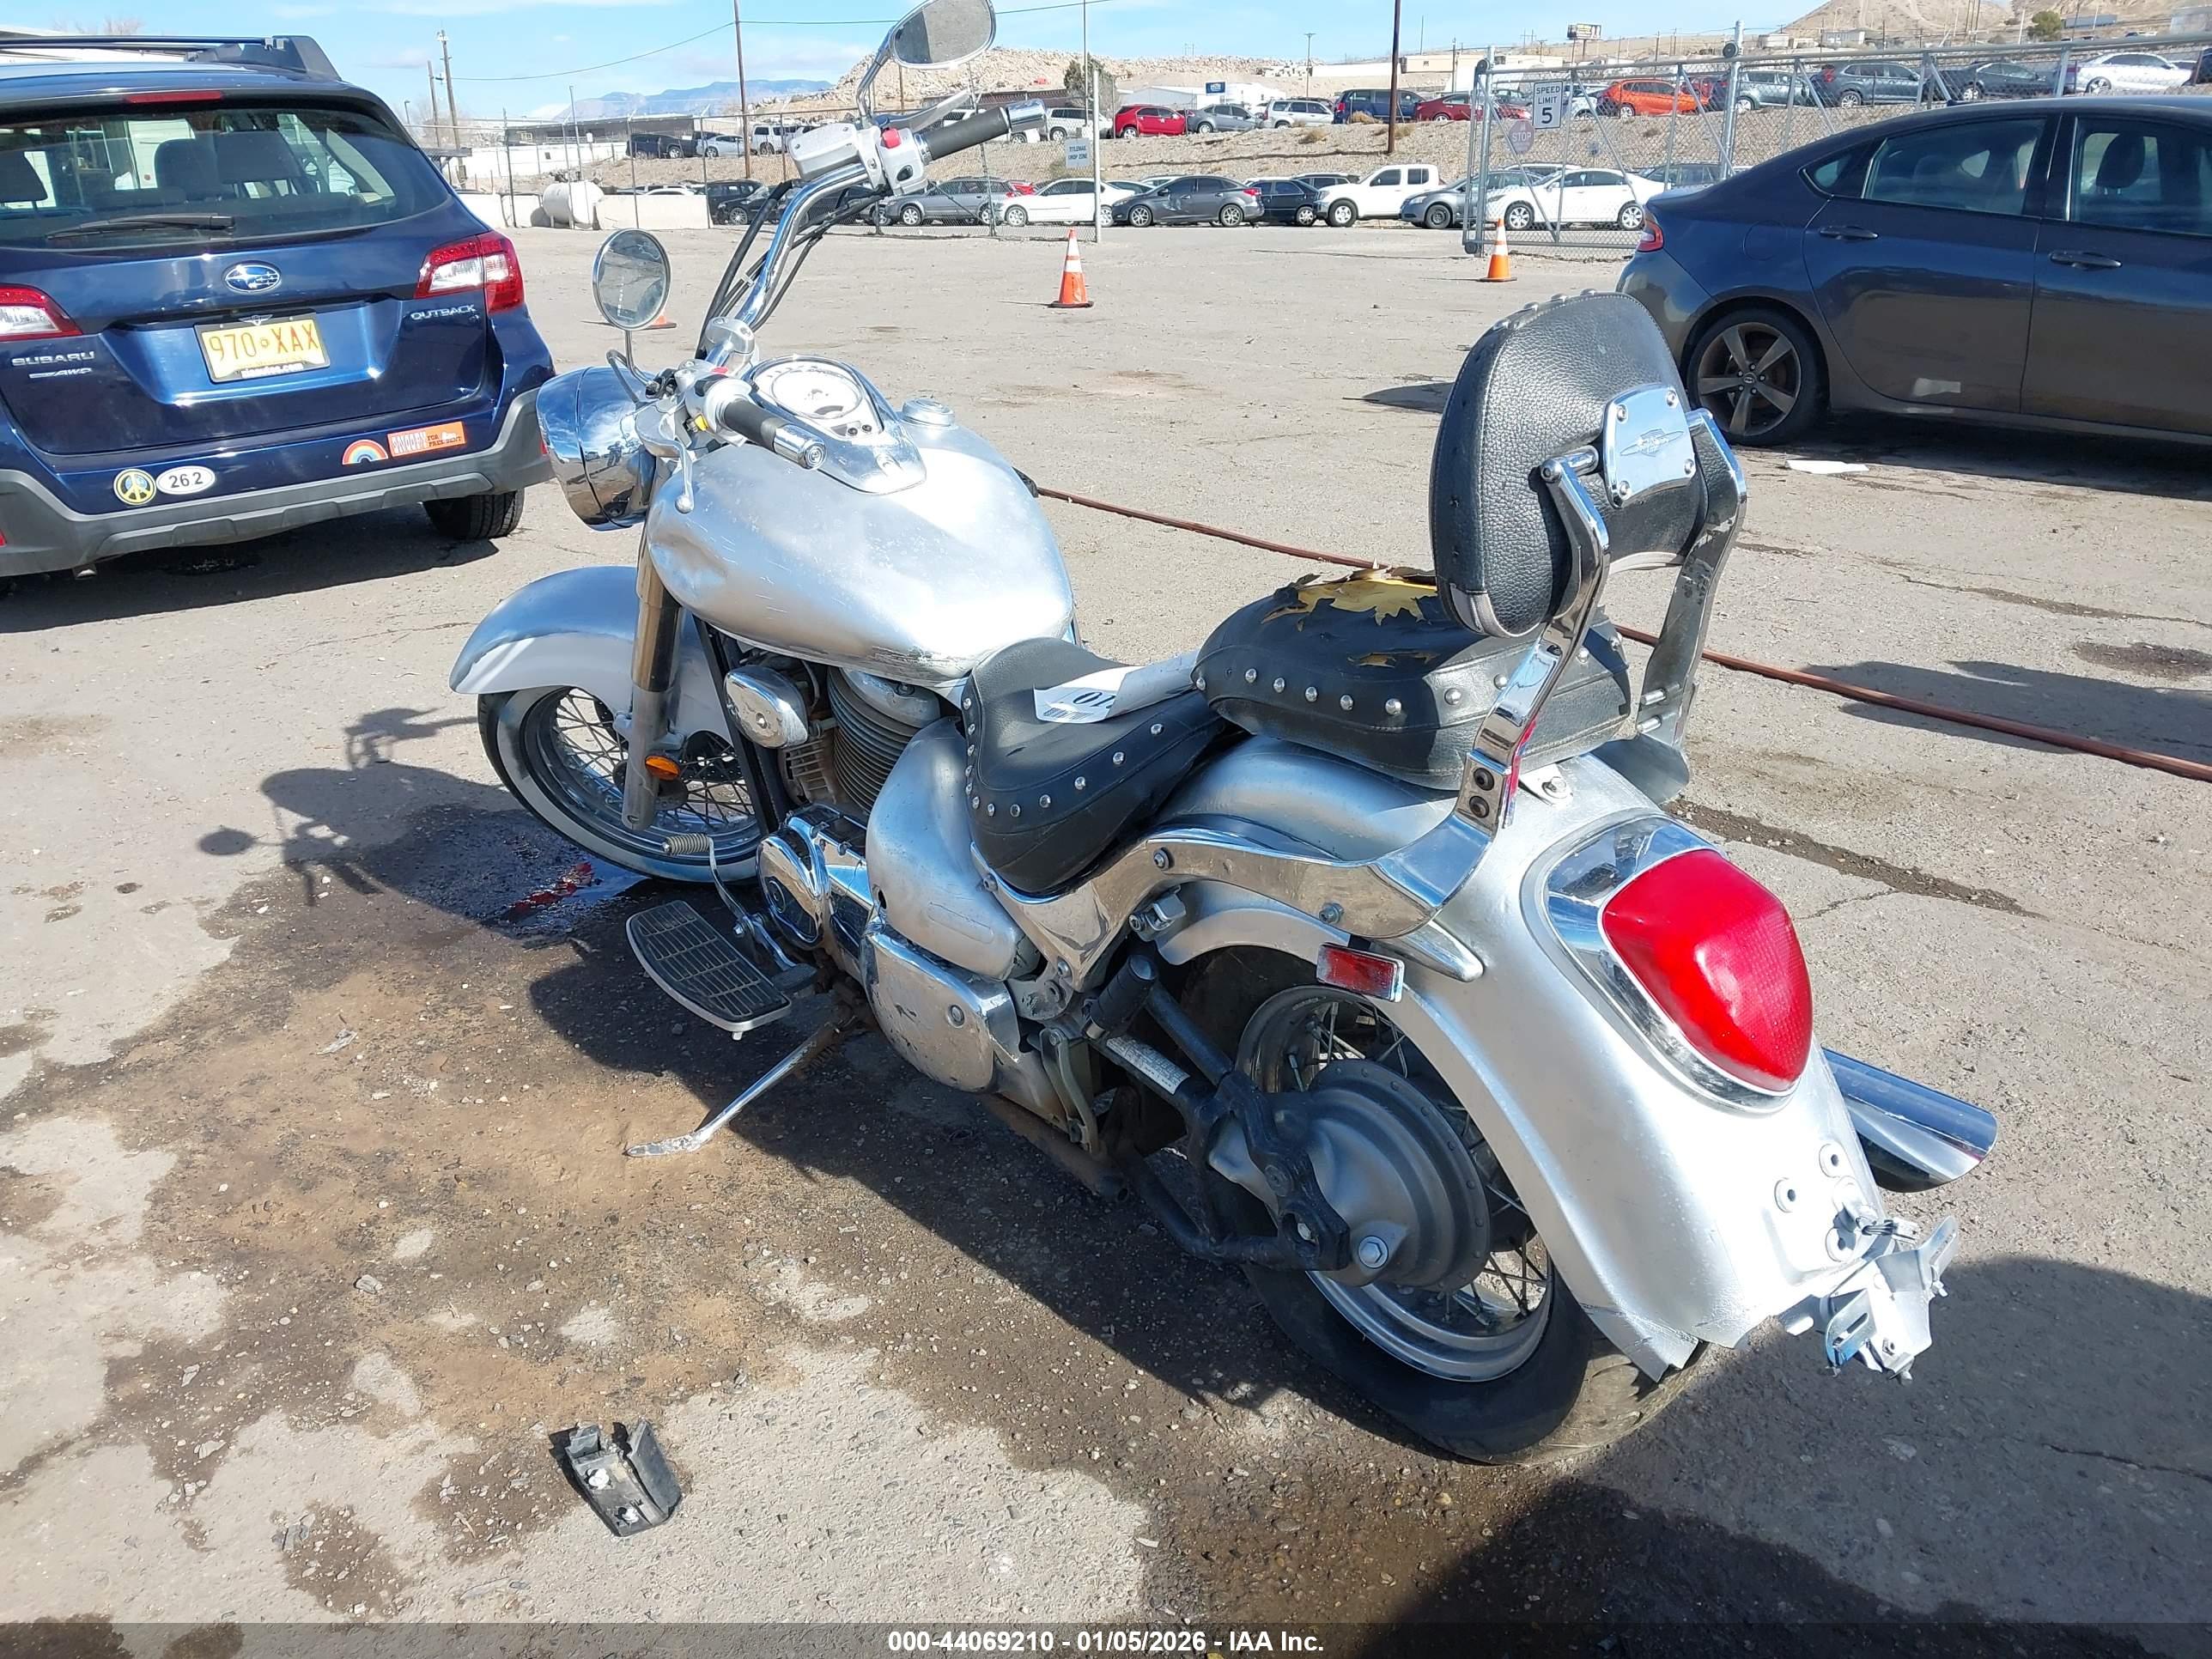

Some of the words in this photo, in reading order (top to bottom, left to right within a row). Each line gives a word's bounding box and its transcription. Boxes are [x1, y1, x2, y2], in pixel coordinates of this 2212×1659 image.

[1536, 86, 1561, 94] SPEED
[1541, 106, 1553, 124] 5
[1512, 131, 1532, 142] STOP
[410, 304, 476, 320] OUTBACK
[209, 331, 257, 362] 970
[270, 323, 319, 354] XAX
[11, 350, 94, 366] SUBARU
